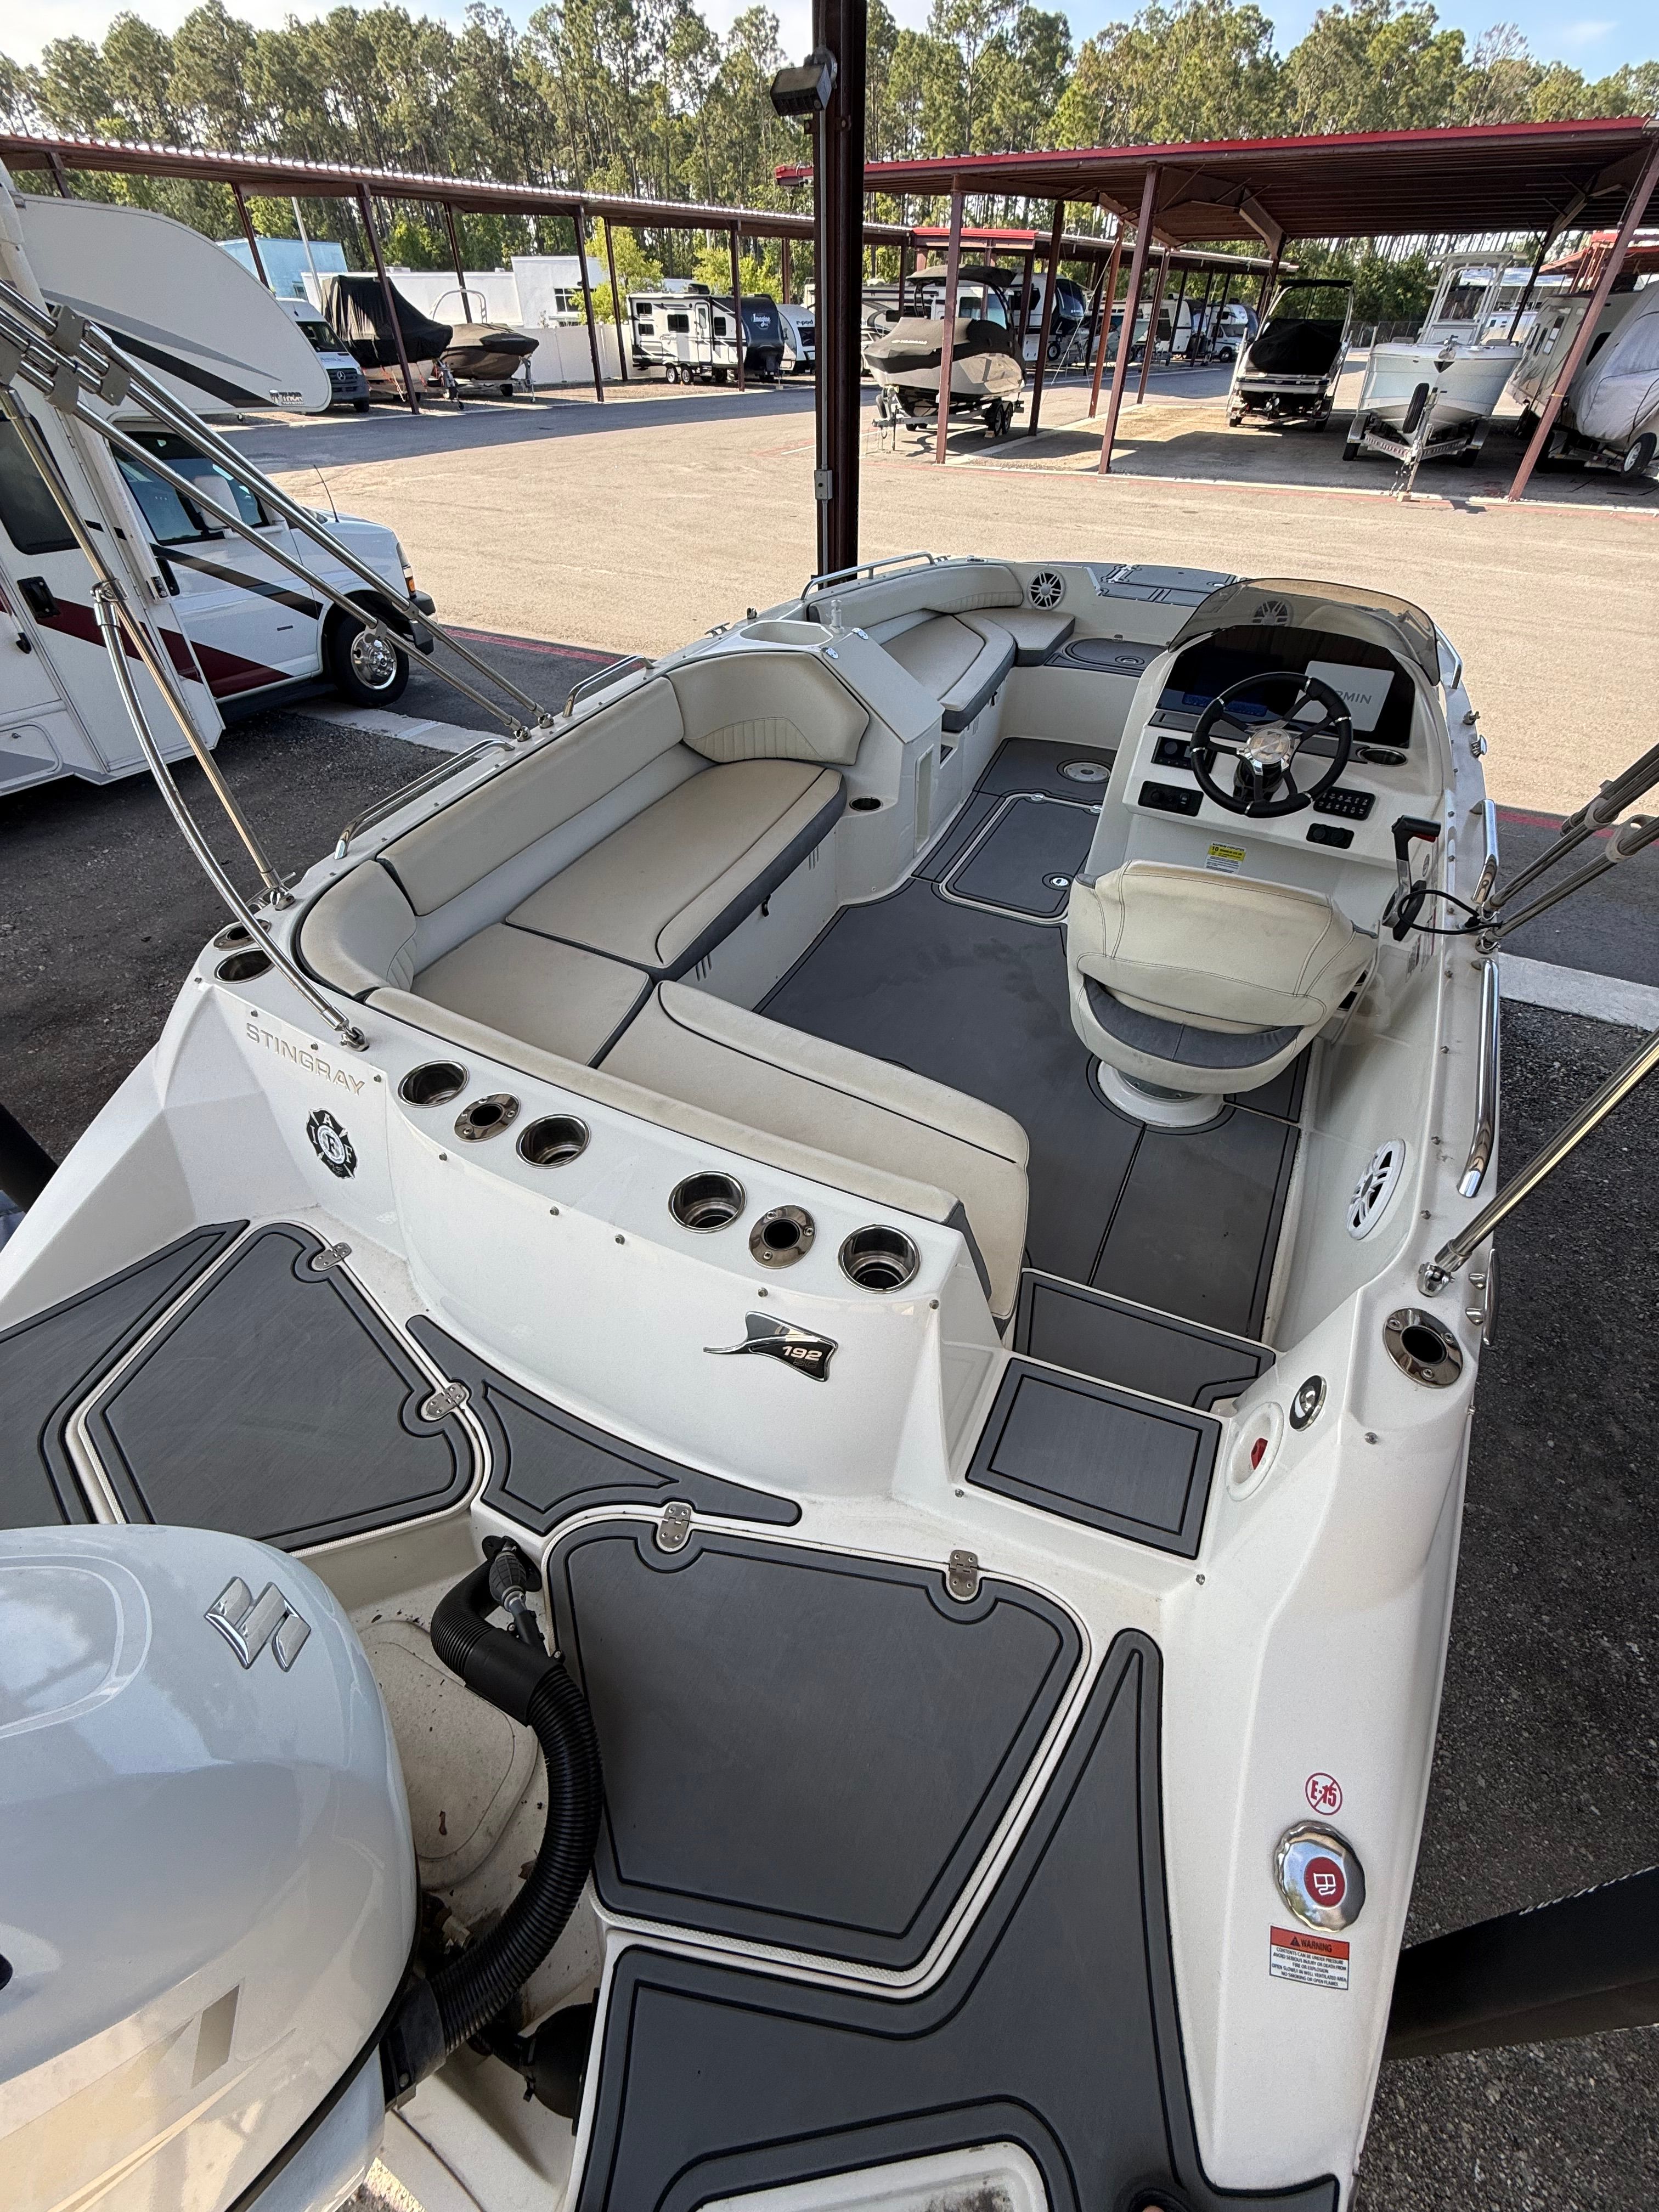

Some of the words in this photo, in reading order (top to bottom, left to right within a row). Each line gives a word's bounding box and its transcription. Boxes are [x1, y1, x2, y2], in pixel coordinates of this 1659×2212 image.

[279, 391, 304, 402] THOR
[246, 1023, 365, 1096] STINGRAY
[782, 1346, 822, 1361] 192
[1311, 1780, 1336, 1807] E-15
[1276, 1947, 1297, 1956] CONTENTS
[1301, 1939, 1332, 1953] WARNING
